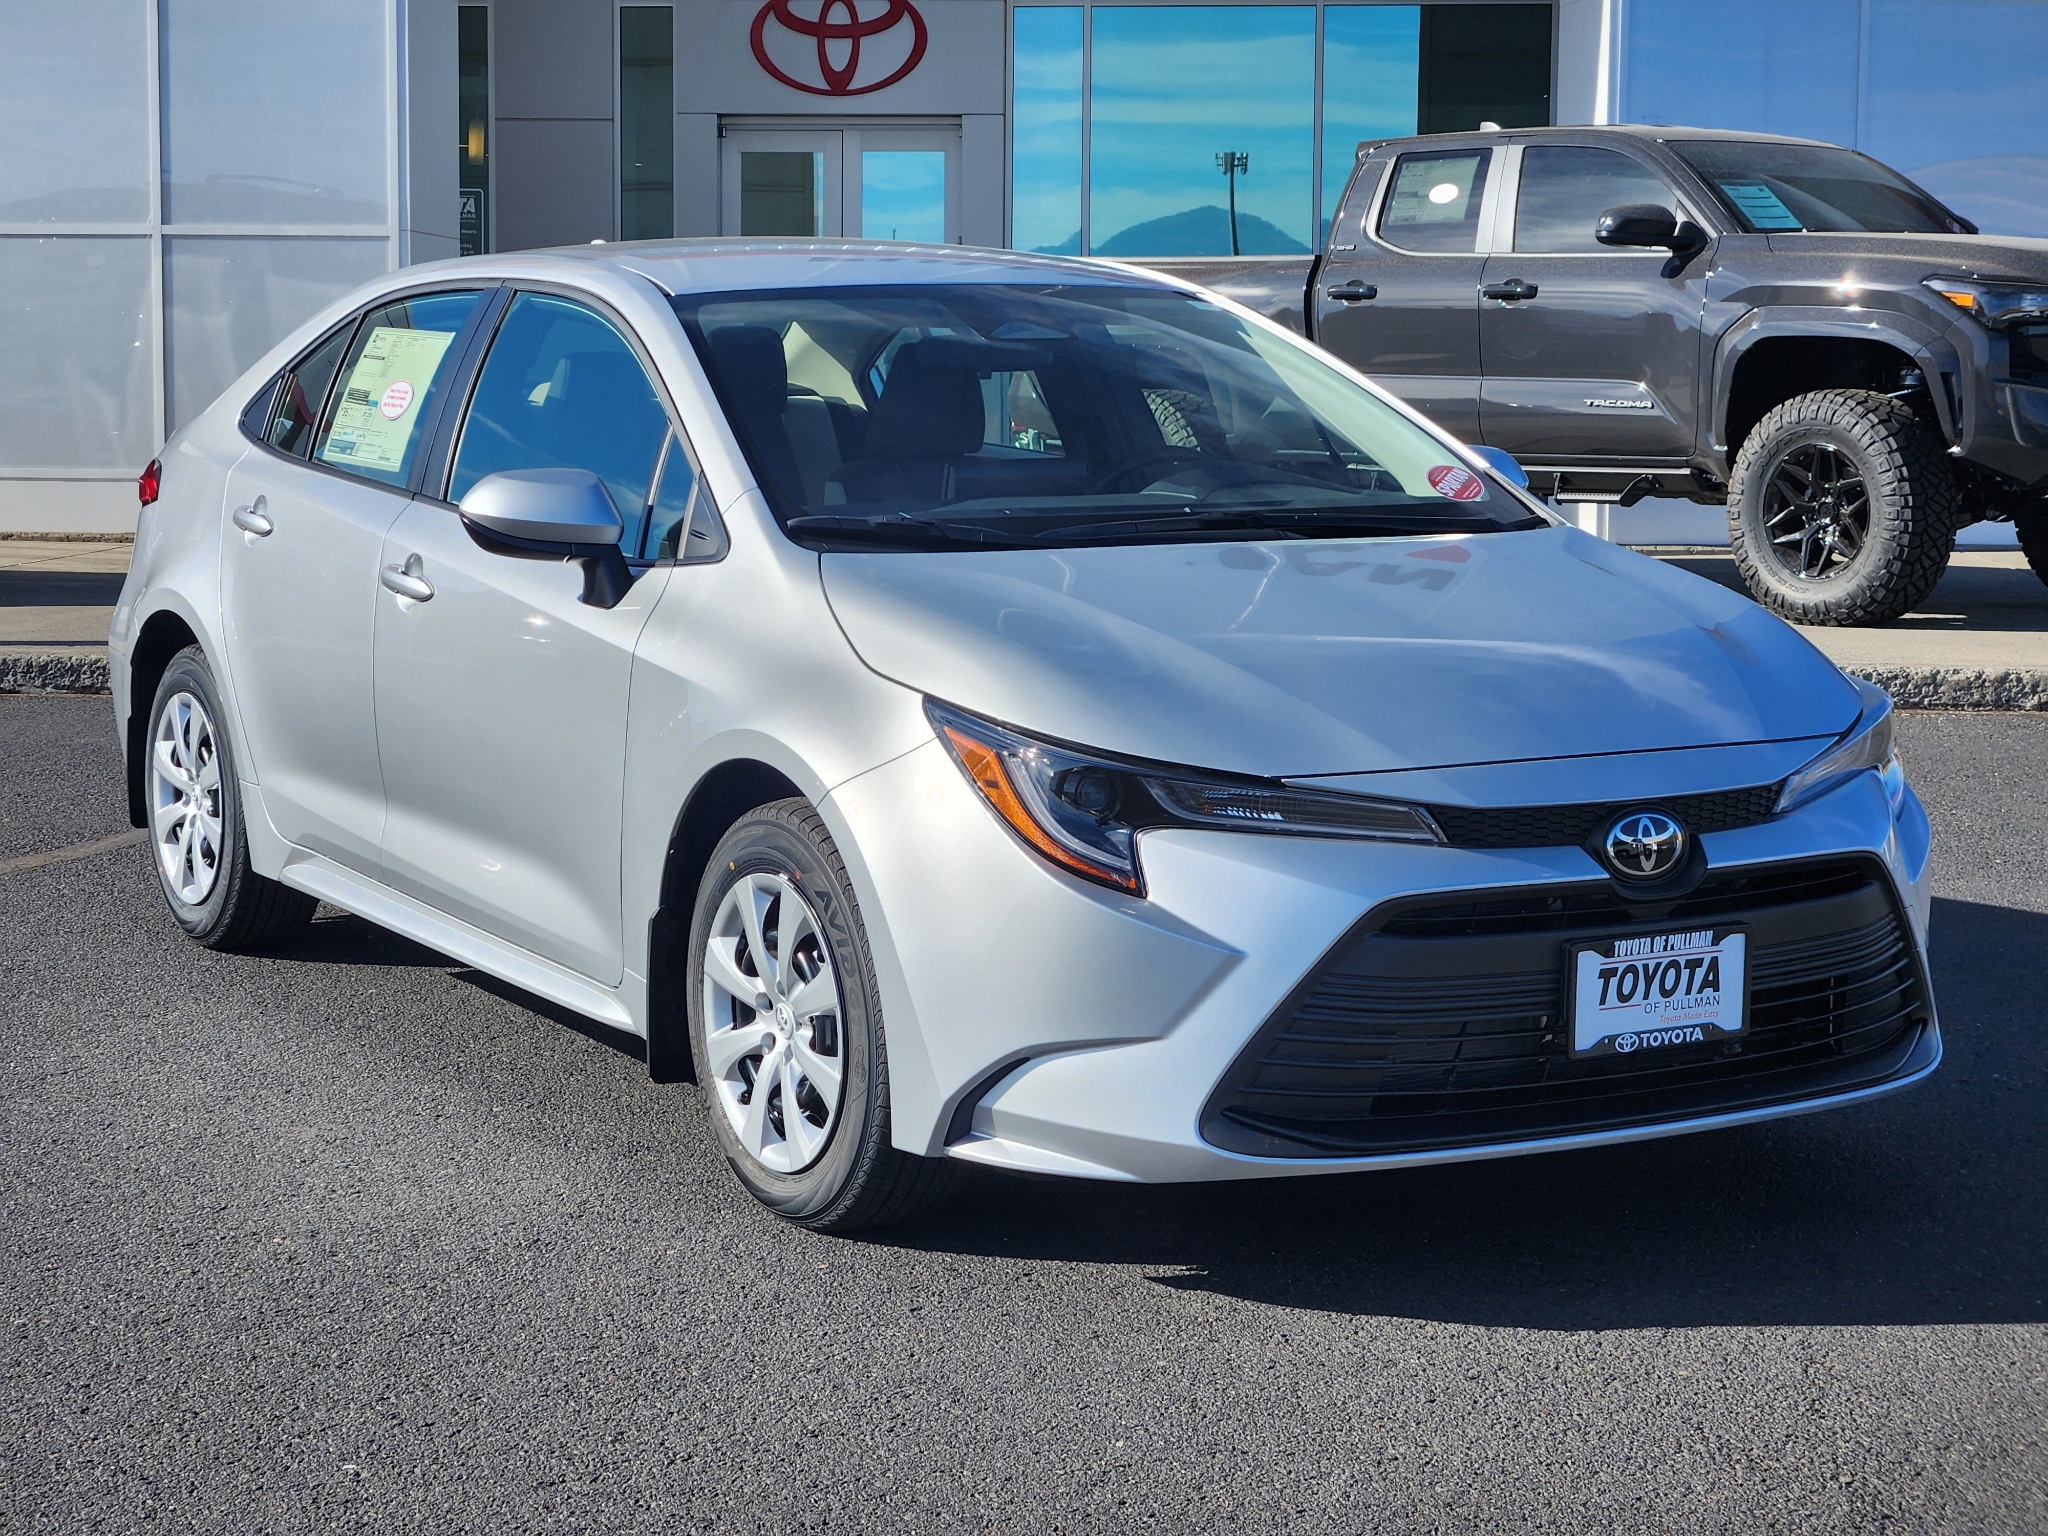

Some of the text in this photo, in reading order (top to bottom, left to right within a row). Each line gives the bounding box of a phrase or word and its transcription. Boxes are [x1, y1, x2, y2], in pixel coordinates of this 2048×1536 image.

[1583, 399, 1653, 409] TACOMA
[813, 889, 857, 980] AVID
[1614, 930, 1714, 958] TOYOTA OF PULLMAN
[1598, 956, 1721, 1006] TOYOTA
[1644, 995, 1721, 1014] OF PULLMAN
[1660, 1010, 1720, 1025] Toyota Made Easy
[1640, 1026, 1704, 1048] TOYOTA
